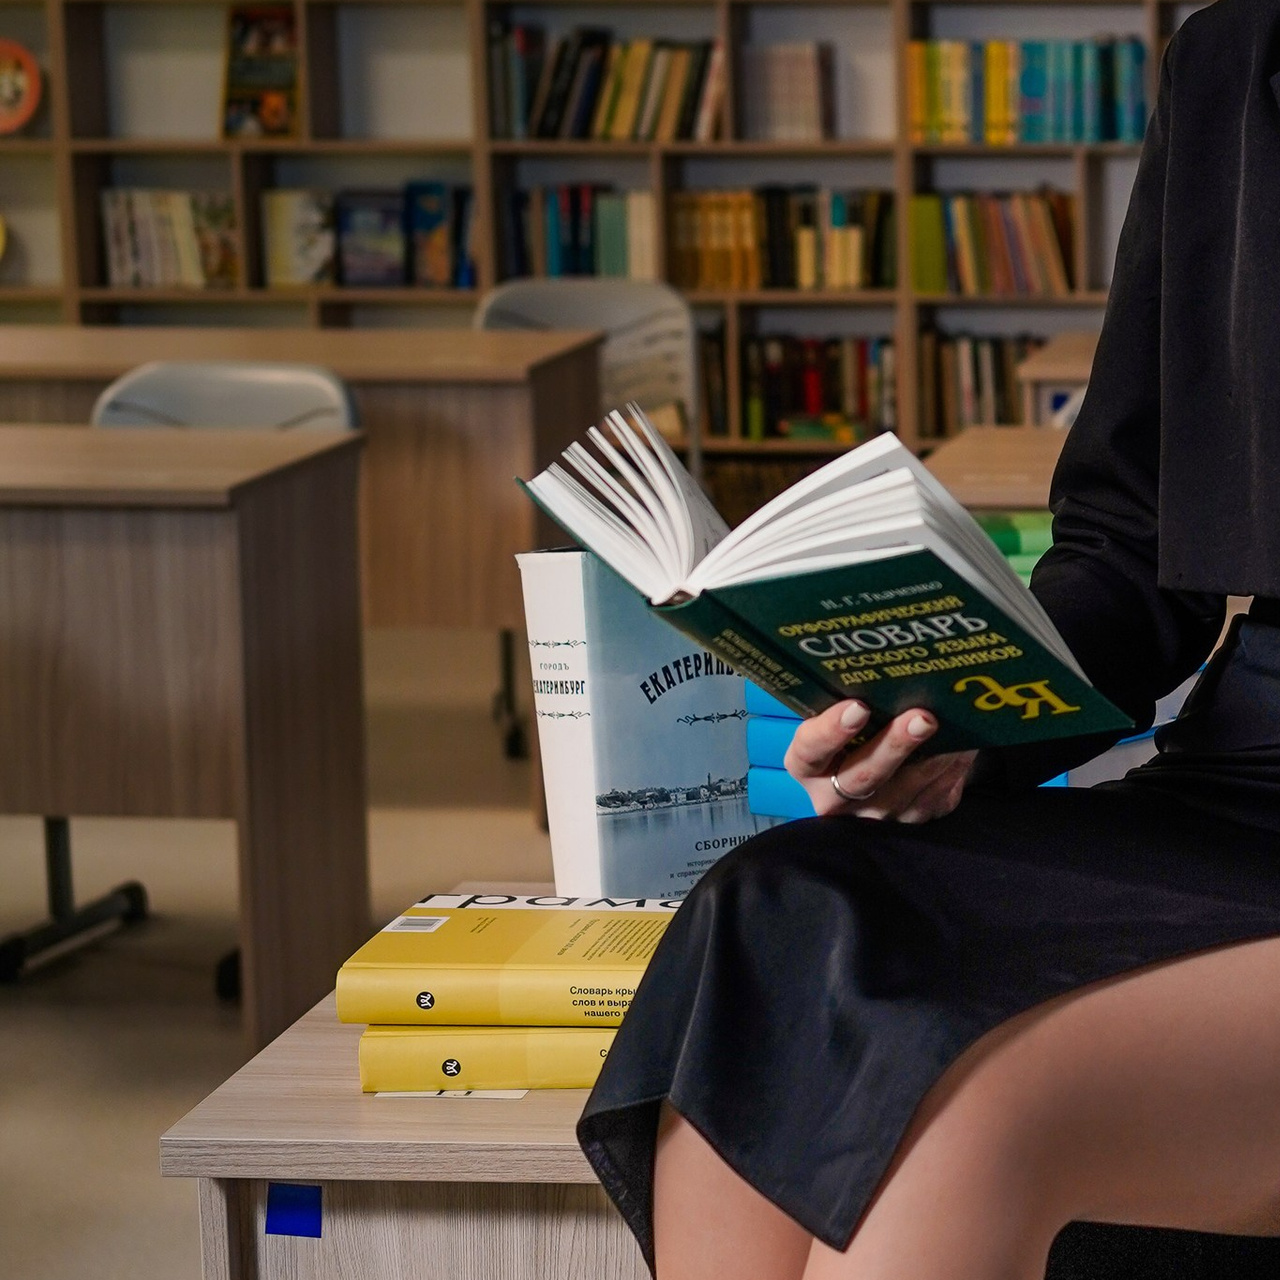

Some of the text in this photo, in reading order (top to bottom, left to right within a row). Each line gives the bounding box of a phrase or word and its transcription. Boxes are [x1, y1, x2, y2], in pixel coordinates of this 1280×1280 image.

[860, 580, 943, 603] Ткаченко
[798, 610, 988, 657] СЛОВАРЬ
[820, 631, 1008, 672] РУССКОГО ЯЗЫКА
[840, 645, 1024, 686] ДЛЯ ШКОЛЬНИКОВ
[640, 652, 741, 704] ЕКАТЕРИН
[570, 986, 637, 997] Словарь кры
[607, 999, 633, 1008] выра
[600, 1048, 608, 1058] С
